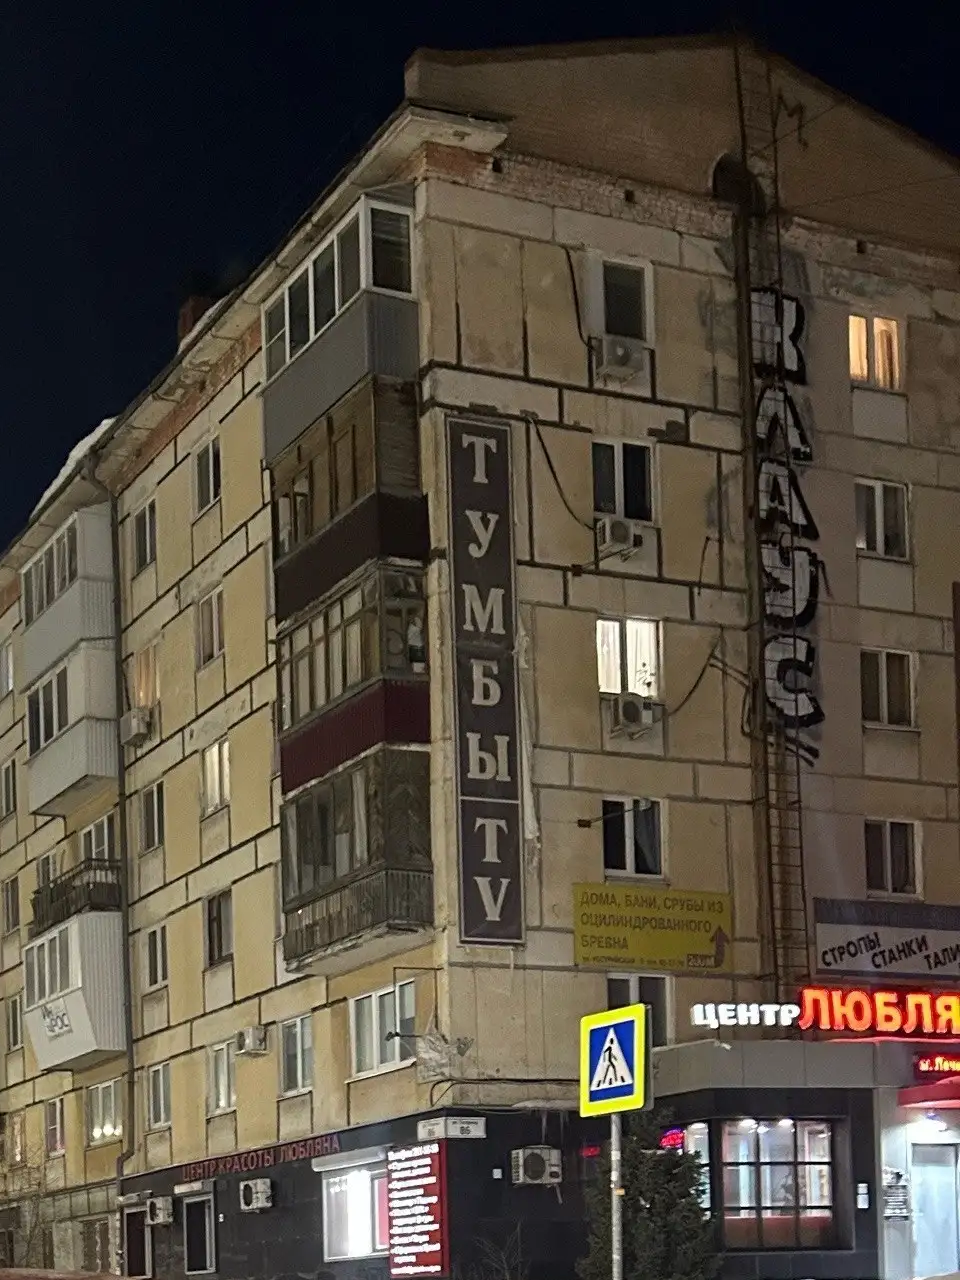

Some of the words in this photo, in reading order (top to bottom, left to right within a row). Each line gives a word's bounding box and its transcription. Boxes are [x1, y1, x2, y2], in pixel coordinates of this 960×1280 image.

[462, 434, 511, 782] ТУМБЫ
[580, 892, 620, 908] ДОМА,
[625, 895, 660, 910] БАНИ,
[663, 897, 705, 912] СРУБЫ
[707, 901, 724, 914] ИЗ
[580, 912, 712, 933] ОЦИЛИНДРОВАННОГО
[581, 934, 629, 949] БРЕВНА
[821, 932, 882, 967] СТРОПЫ
[871, 934, 929, 969] СТАНКИ
[691, 1003, 800, 1029] ЦЕНТР
[798, 988, 960, 1034] ЛЮБЛЯ
[182, 1162, 216, 1181] ЦЕНТР
[217, 1150, 274, 1175] КРАСОТЫ
[279, 1135, 340, 1163] ЛЮБЛЯНА
